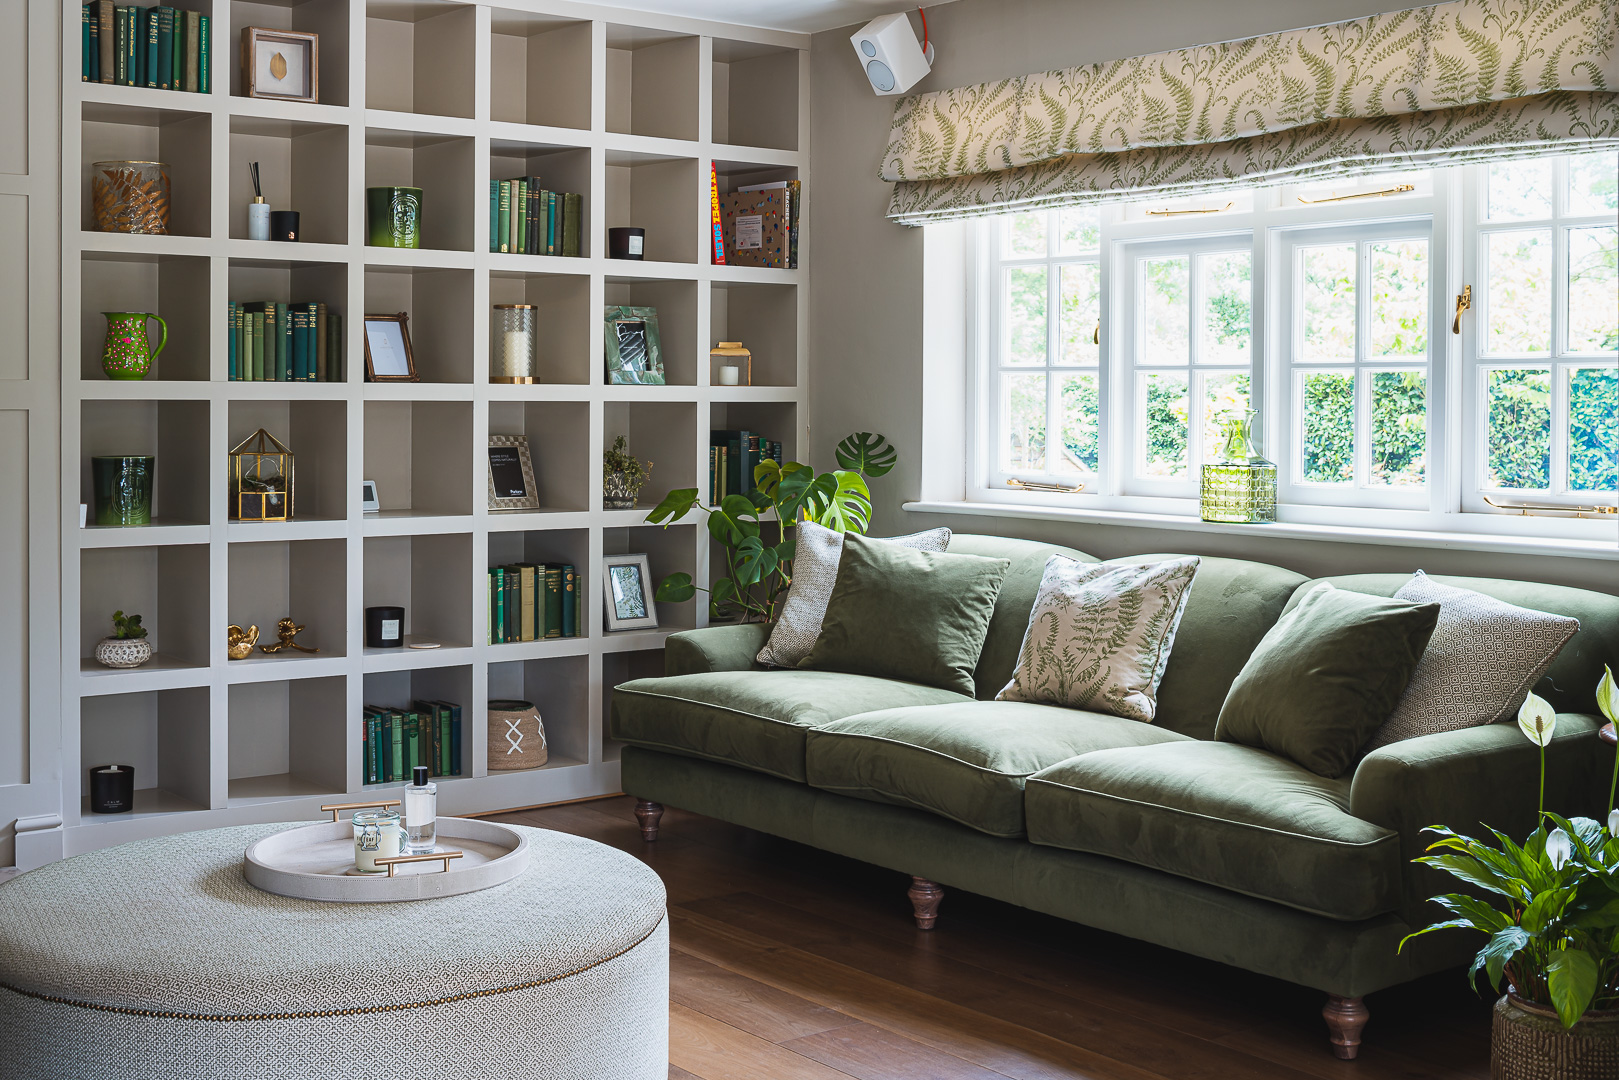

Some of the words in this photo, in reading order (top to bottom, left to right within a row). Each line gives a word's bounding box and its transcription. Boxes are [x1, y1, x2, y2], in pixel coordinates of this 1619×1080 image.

[710, 172, 716, 184] ST
[710, 185, 720, 224] TROPEZ
[714, 224, 724, 259] SOLEIL
